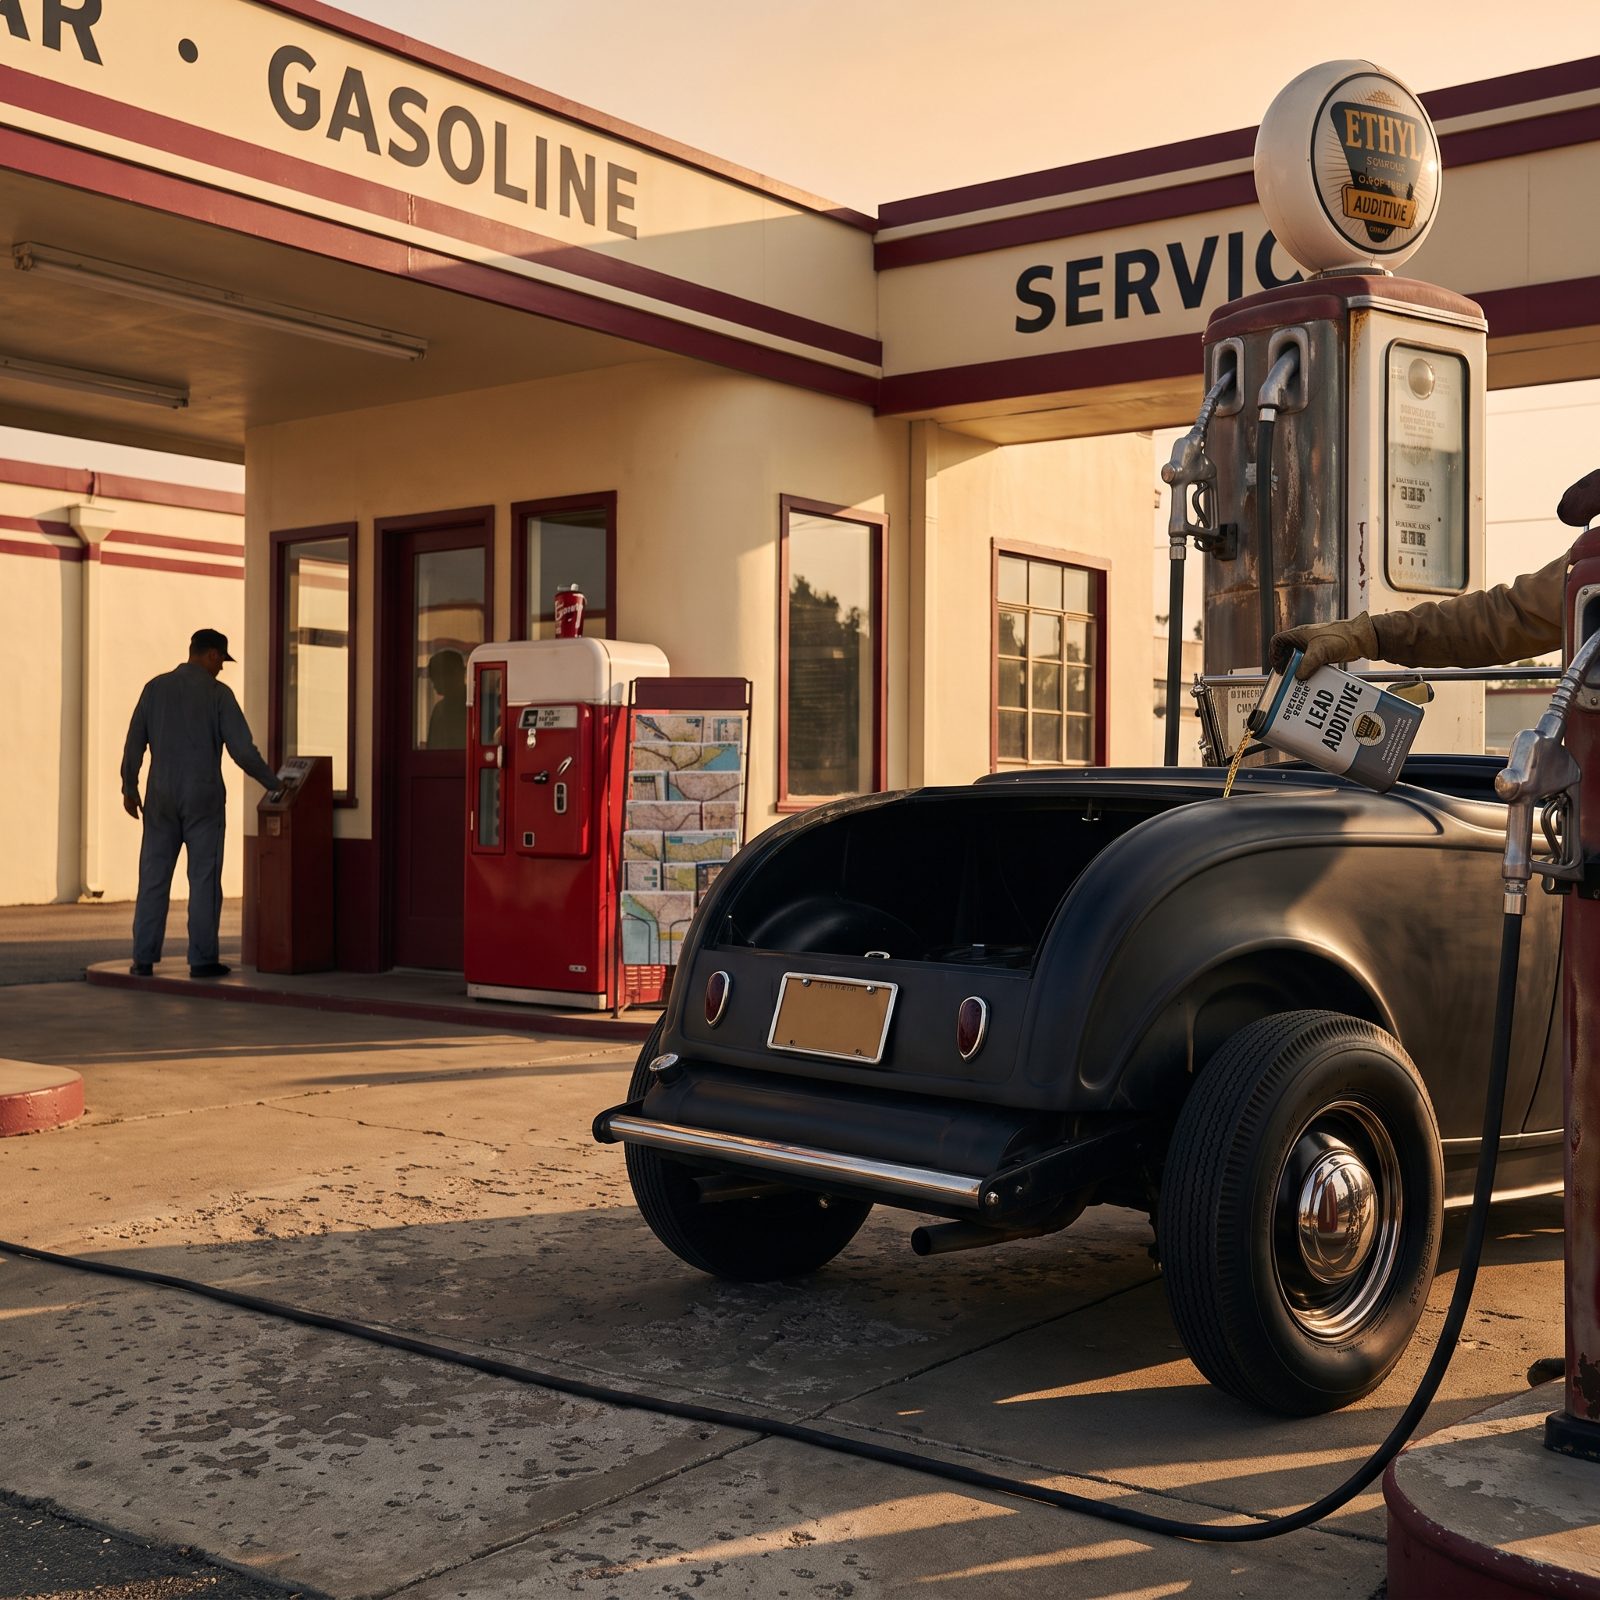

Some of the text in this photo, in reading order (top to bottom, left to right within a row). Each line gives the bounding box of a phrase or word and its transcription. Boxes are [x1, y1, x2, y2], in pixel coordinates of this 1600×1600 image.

[267, 44, 639, 241] GASOLINE
[1344, 109, 1422, 162] ETHYL
[1305, 689, 1335, 730] LEAD
[1321, 681, 1363, 753] ADDITIVE
